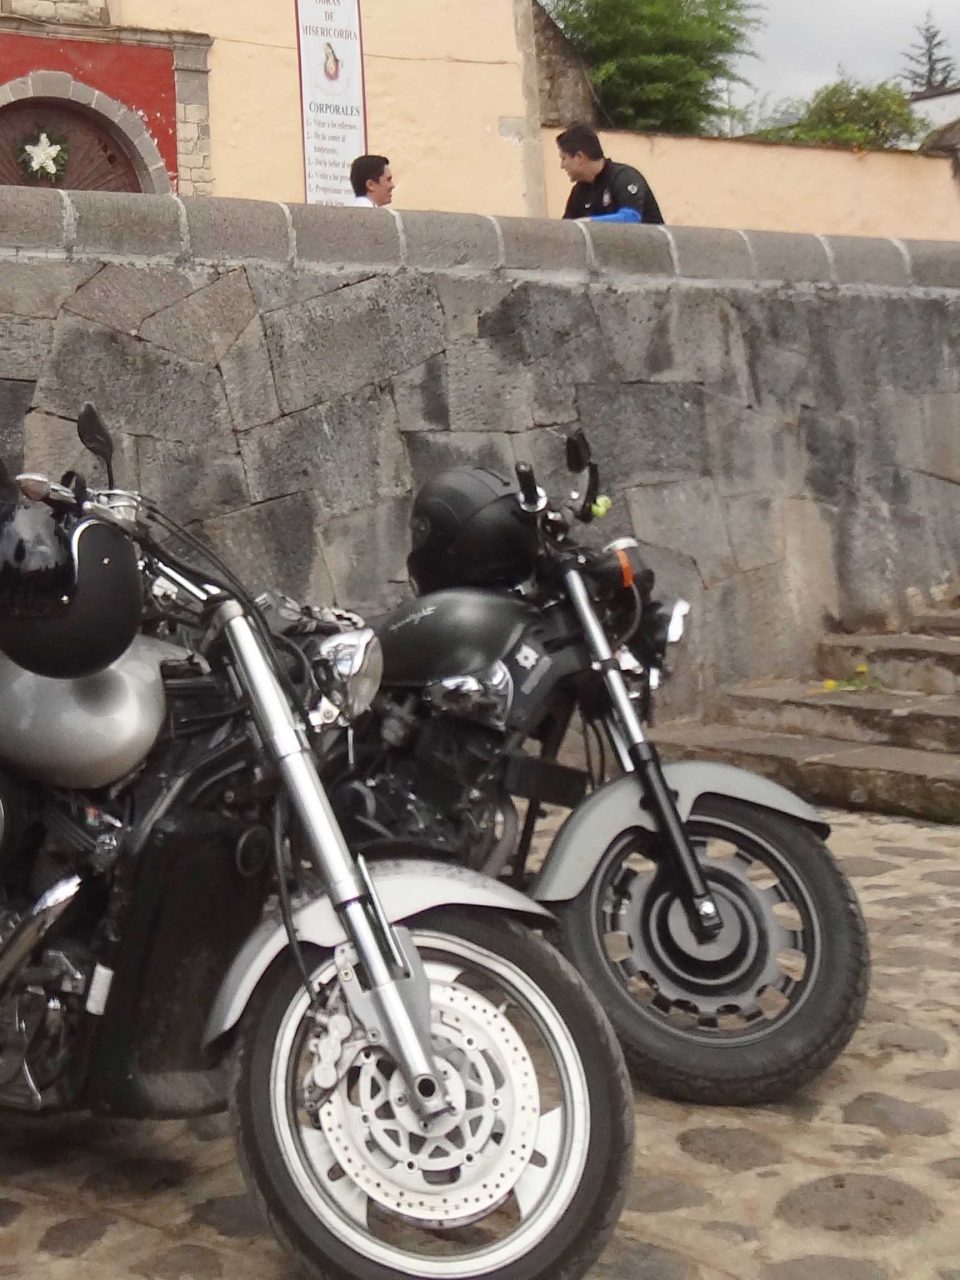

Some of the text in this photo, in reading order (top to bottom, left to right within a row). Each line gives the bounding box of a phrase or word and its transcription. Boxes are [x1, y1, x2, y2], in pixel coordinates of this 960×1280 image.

[324, 11, 334, 22] DE
[301, 24, 358, 41] MISERICORDIA
[308, 101, 360, 117] CORPORALES
